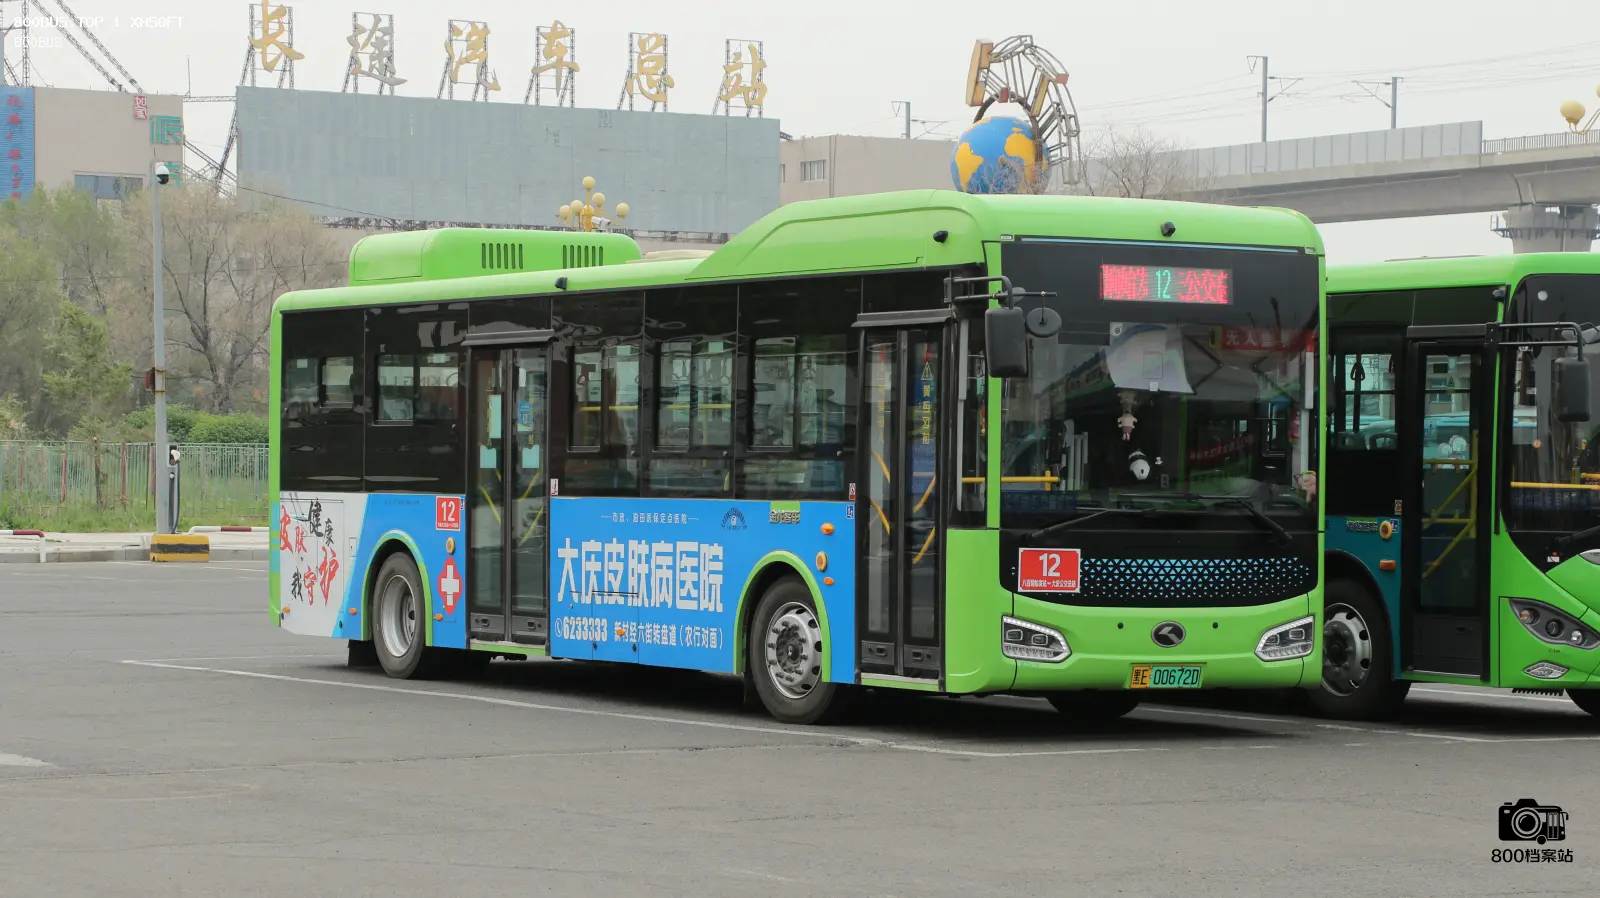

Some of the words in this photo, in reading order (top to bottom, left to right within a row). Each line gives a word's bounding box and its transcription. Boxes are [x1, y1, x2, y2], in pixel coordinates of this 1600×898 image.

[248, 0, 767, 107] 长途汽车总站
[1156, 269, 1171, 299] 12
[441, 500, 456, 522] 12
[557, 537, 724, 613] 大庆皮肤病医院
[1039, 553, 1061, 577] 12
[563, 616, 608, 642] 6233333
